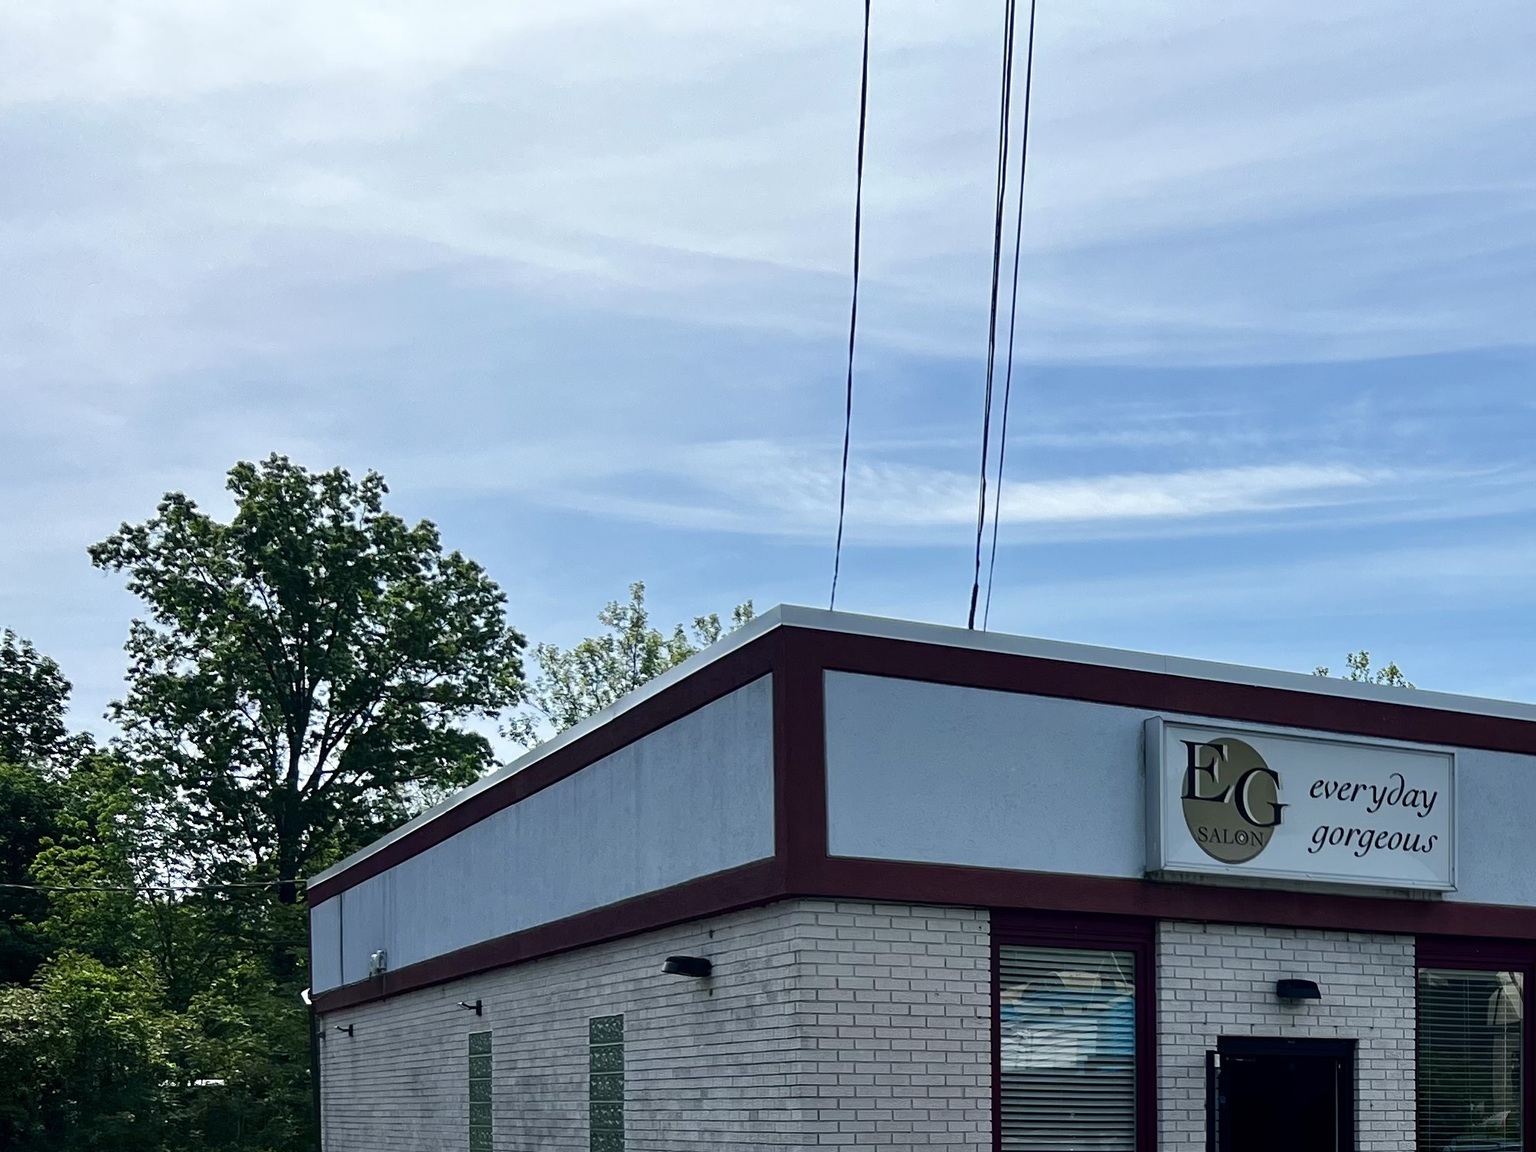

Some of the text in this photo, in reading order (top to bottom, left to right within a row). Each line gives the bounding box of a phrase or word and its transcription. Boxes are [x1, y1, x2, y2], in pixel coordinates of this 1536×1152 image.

[1309, 772, 1438, 817] everyday
[1197, 826, 1264, 847] SALON
[1307, 824, 1438, 857] gorgeous
